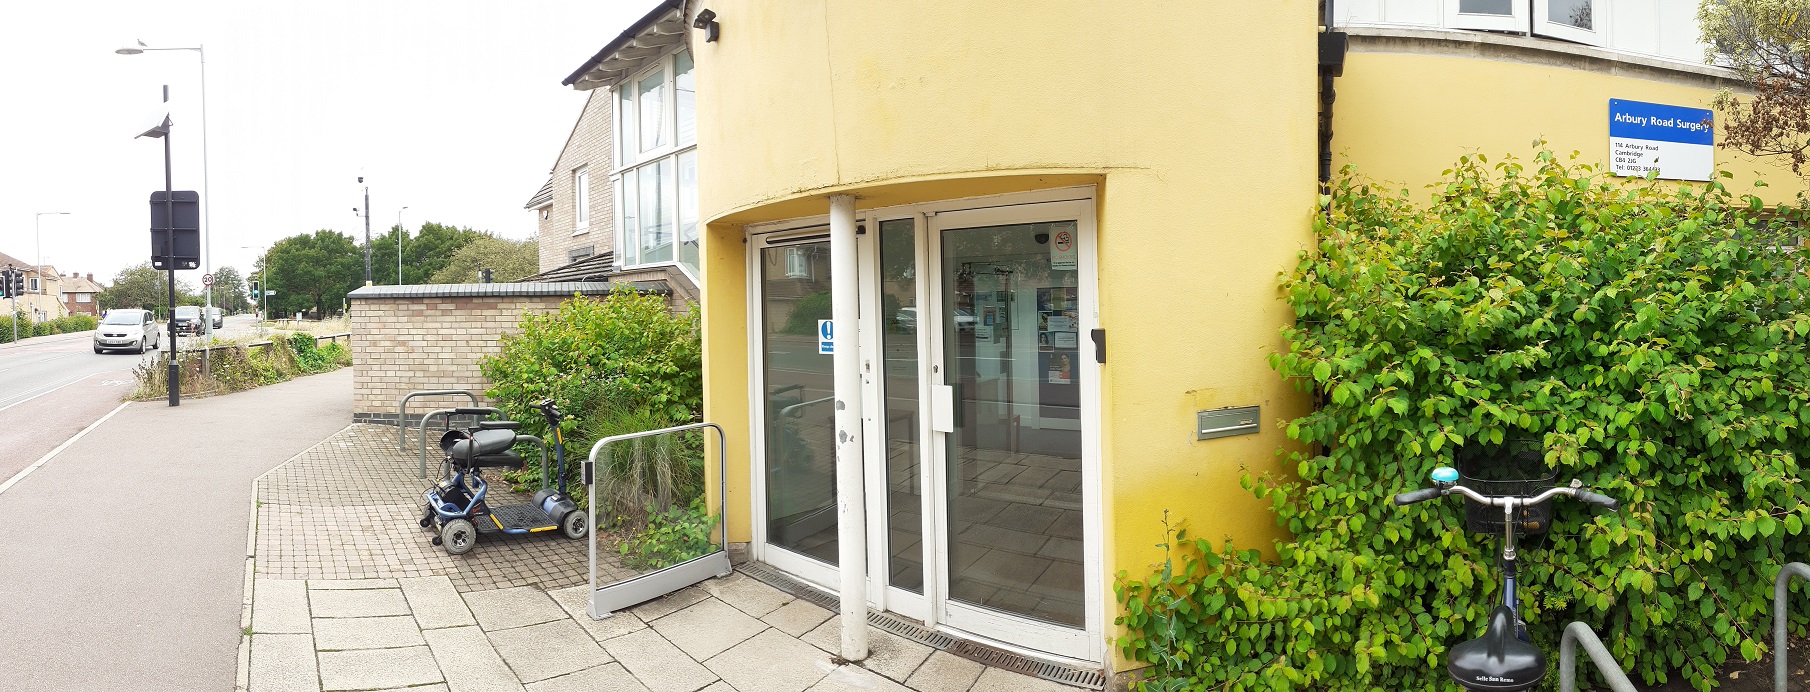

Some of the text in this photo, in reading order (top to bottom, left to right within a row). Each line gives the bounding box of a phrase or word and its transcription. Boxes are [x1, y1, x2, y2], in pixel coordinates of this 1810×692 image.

[1614, 112, 1710, 132] Arbury Road Surgery
[1615, 150, 1644, 158] Cambridge
